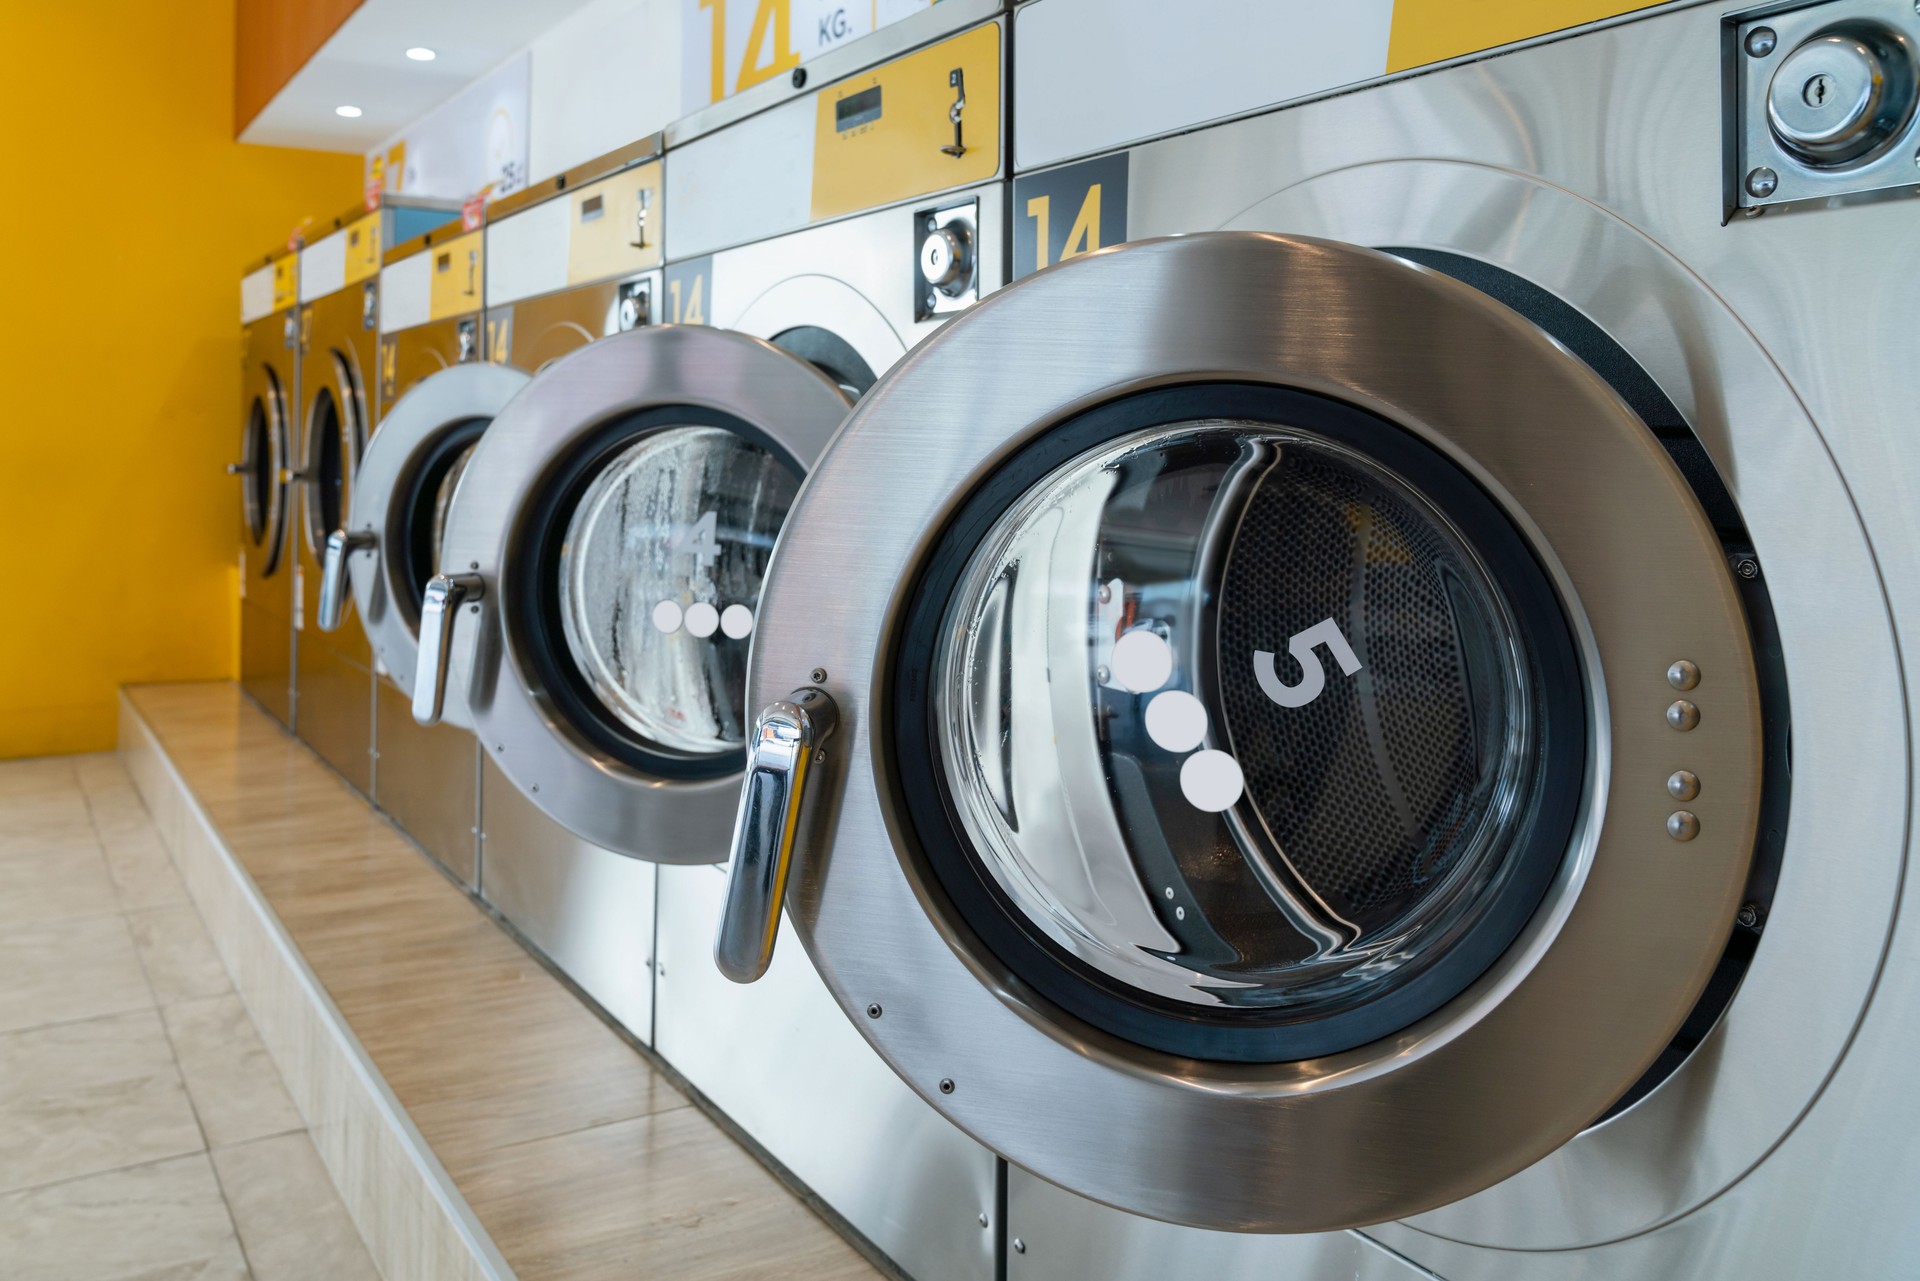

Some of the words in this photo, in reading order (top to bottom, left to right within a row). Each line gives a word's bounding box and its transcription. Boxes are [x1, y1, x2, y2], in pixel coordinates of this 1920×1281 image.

[698, 0, 800, 104] 14
[819, 9, 852, 46] KG.
[1027, 184, 1101, 271] 14
[670, 274, 704, 325] 14
[487, 319, 508, 366] 14
[678, 511, 721, 567] 4
[1253, 617, 1362, 708] 5
